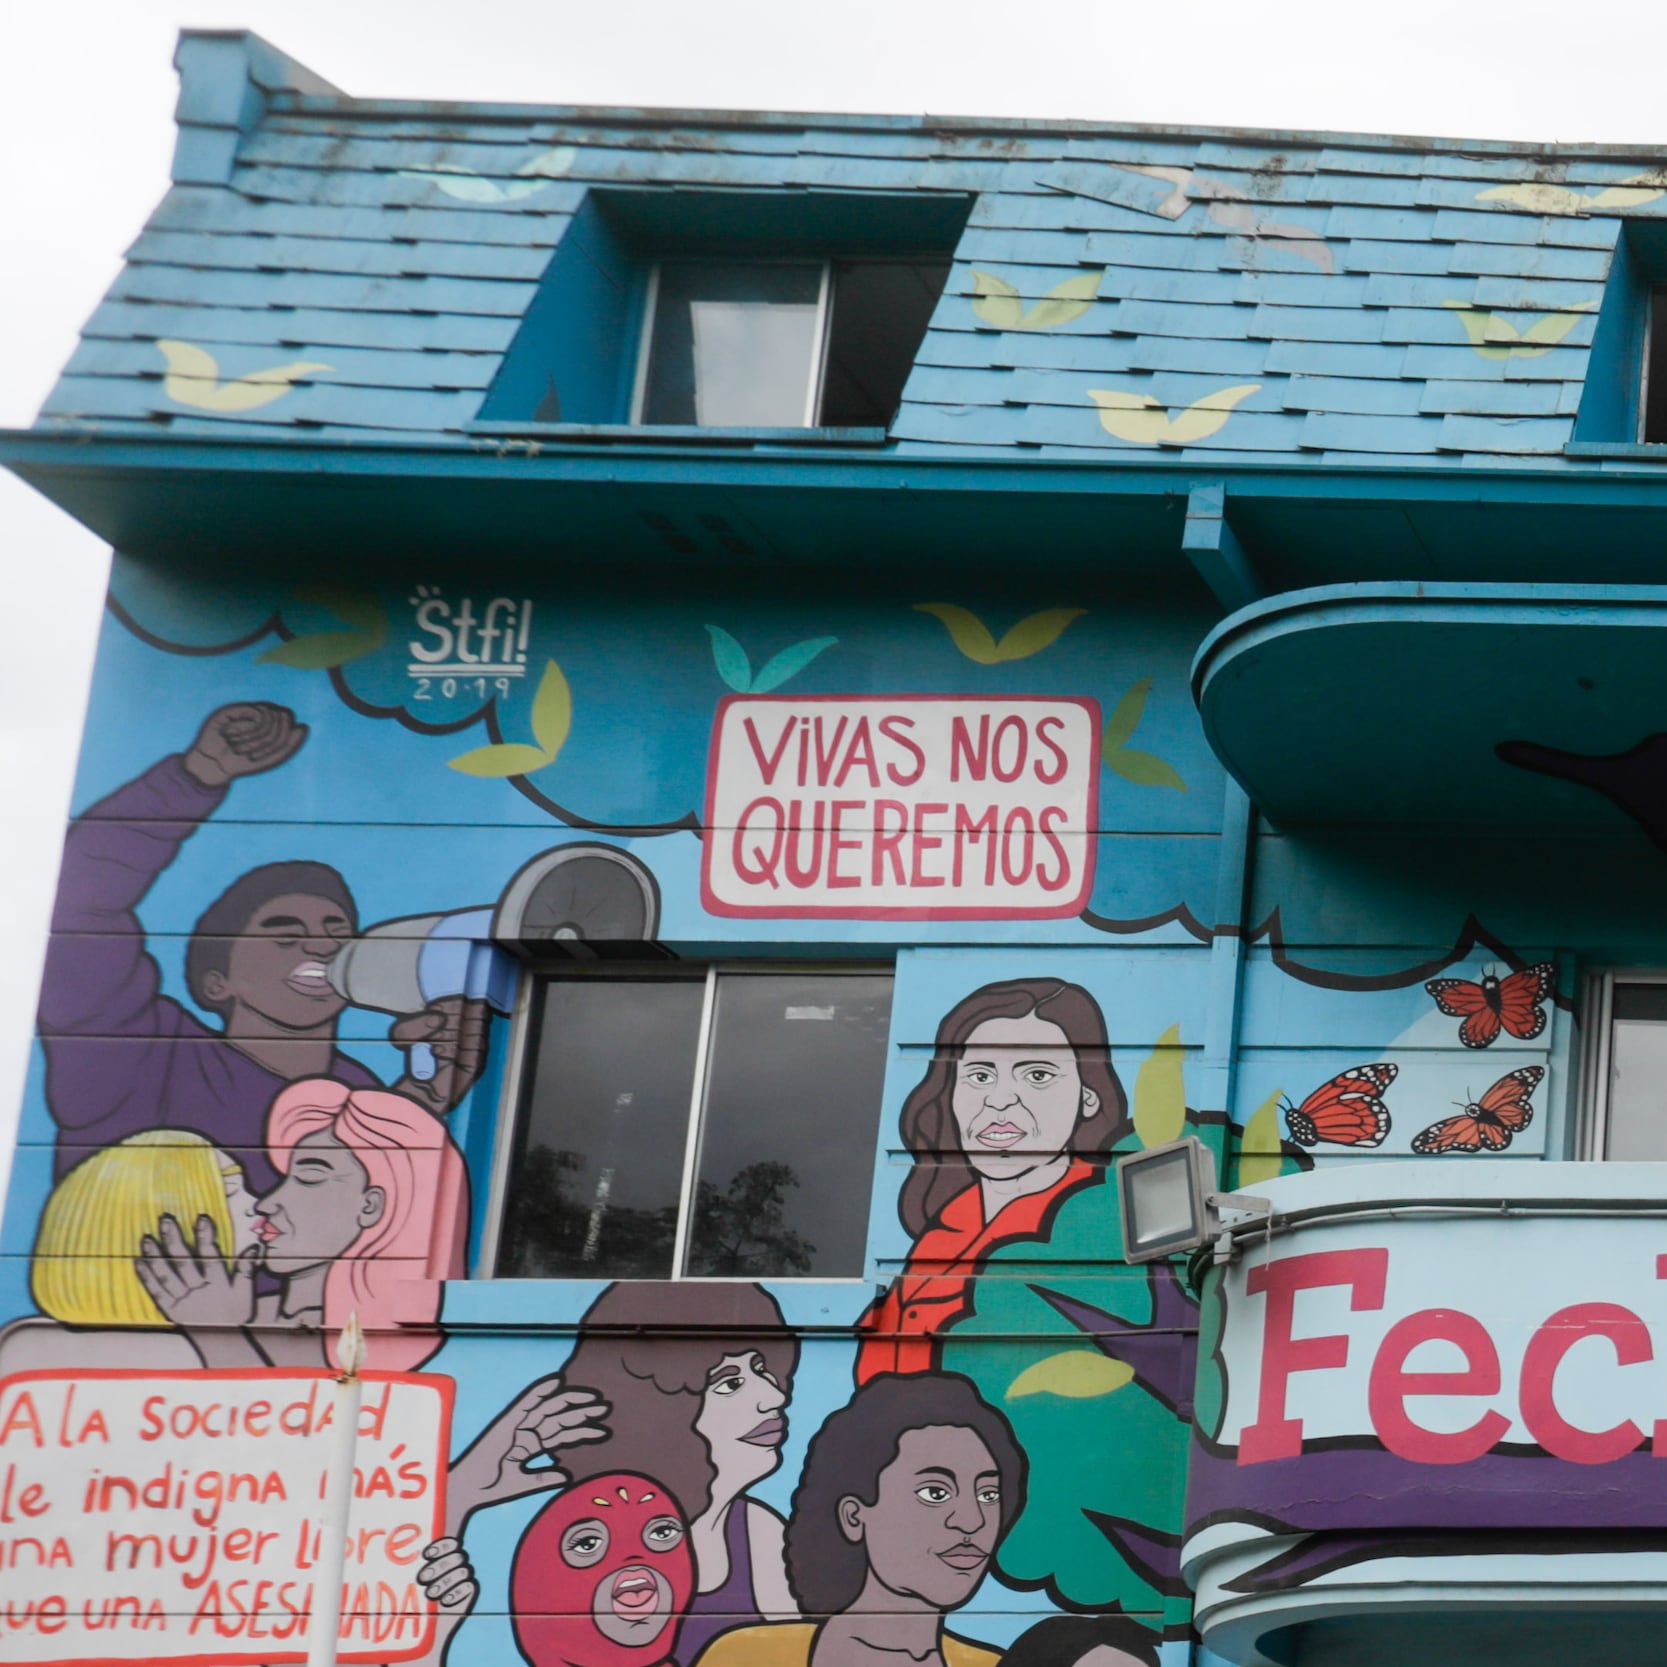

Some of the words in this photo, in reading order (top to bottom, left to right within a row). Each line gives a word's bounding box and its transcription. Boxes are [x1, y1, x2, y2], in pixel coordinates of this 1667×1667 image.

[742, 714, 926, 788] VIVAS
[950, 713, 1069, 785] NOS
[732, 796, 1071, 891] QUEREMOS
[0, 1391, 45, 1448] A
[0, 1463, 51, 1523] le
[105, 1526, 280, 1590] mujer
[0, 1595, 69, 1640] ue
